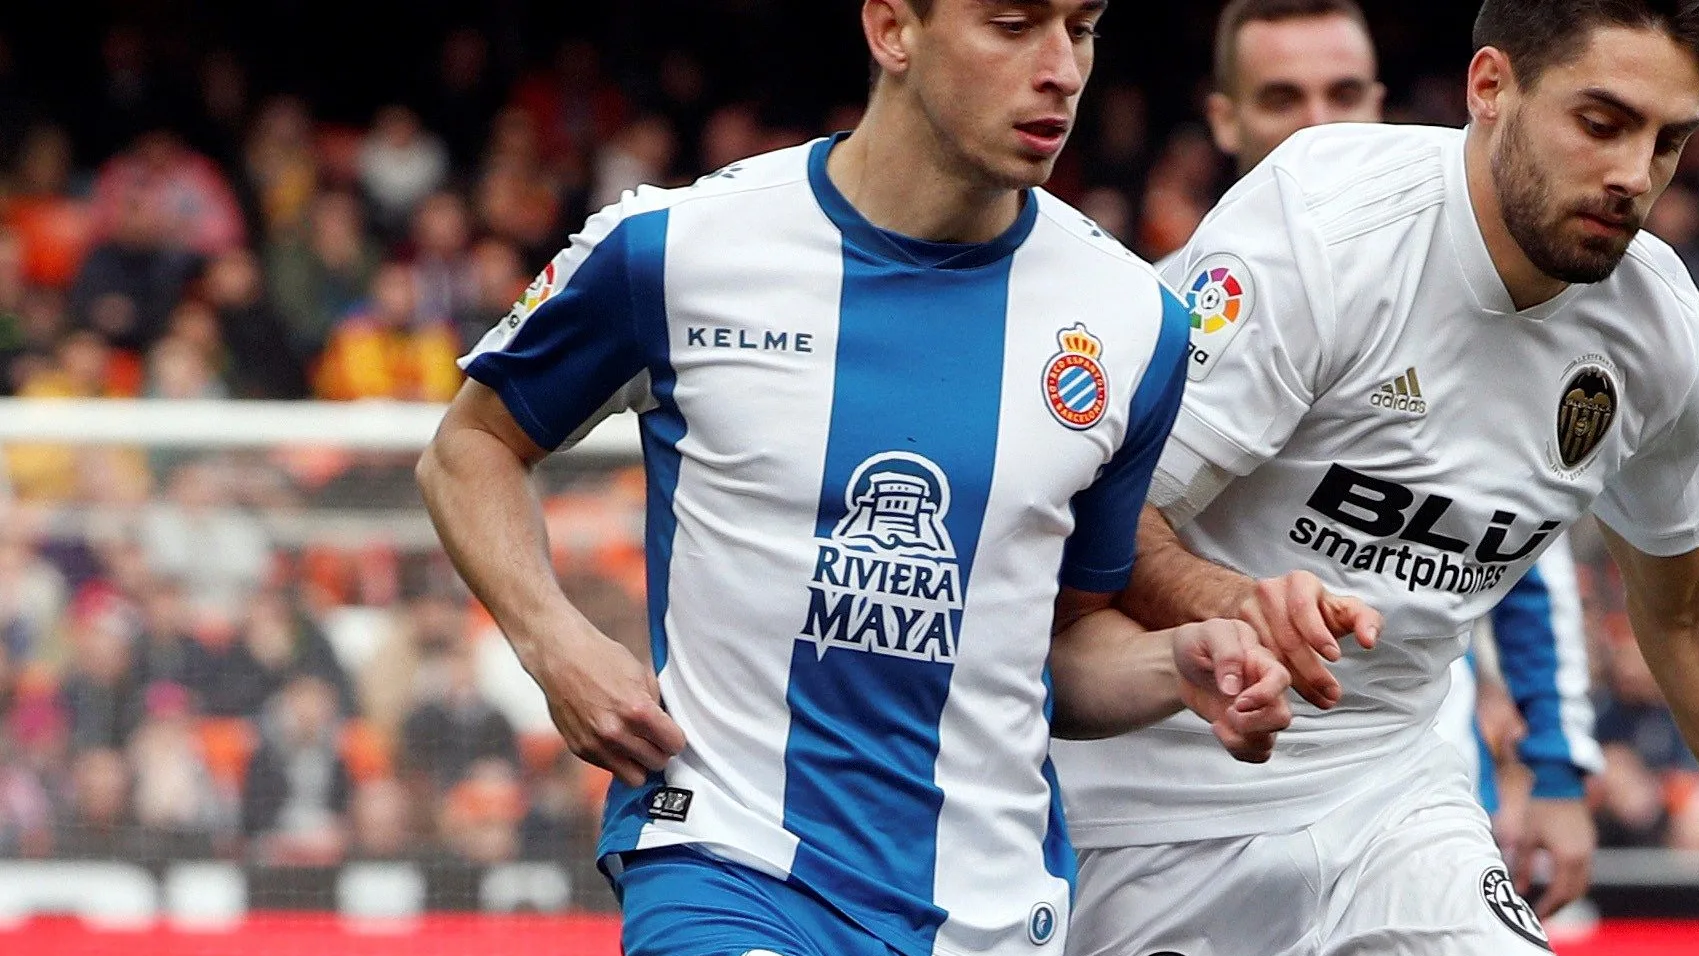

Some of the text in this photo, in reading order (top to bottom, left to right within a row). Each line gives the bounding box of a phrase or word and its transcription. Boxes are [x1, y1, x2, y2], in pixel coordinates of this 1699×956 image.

[687, 326, 814, 353] KELME
[1370, 393, 1427, 414] adidas
[1306, 462, 1562, 564] BLU
[811, 545, 956, 602] RIVIERA
[1289, 516, 1507, 592] smartphones
[799, 585, 951, 657] MAYA
[1484, 871, 1503, 904] ALFA
